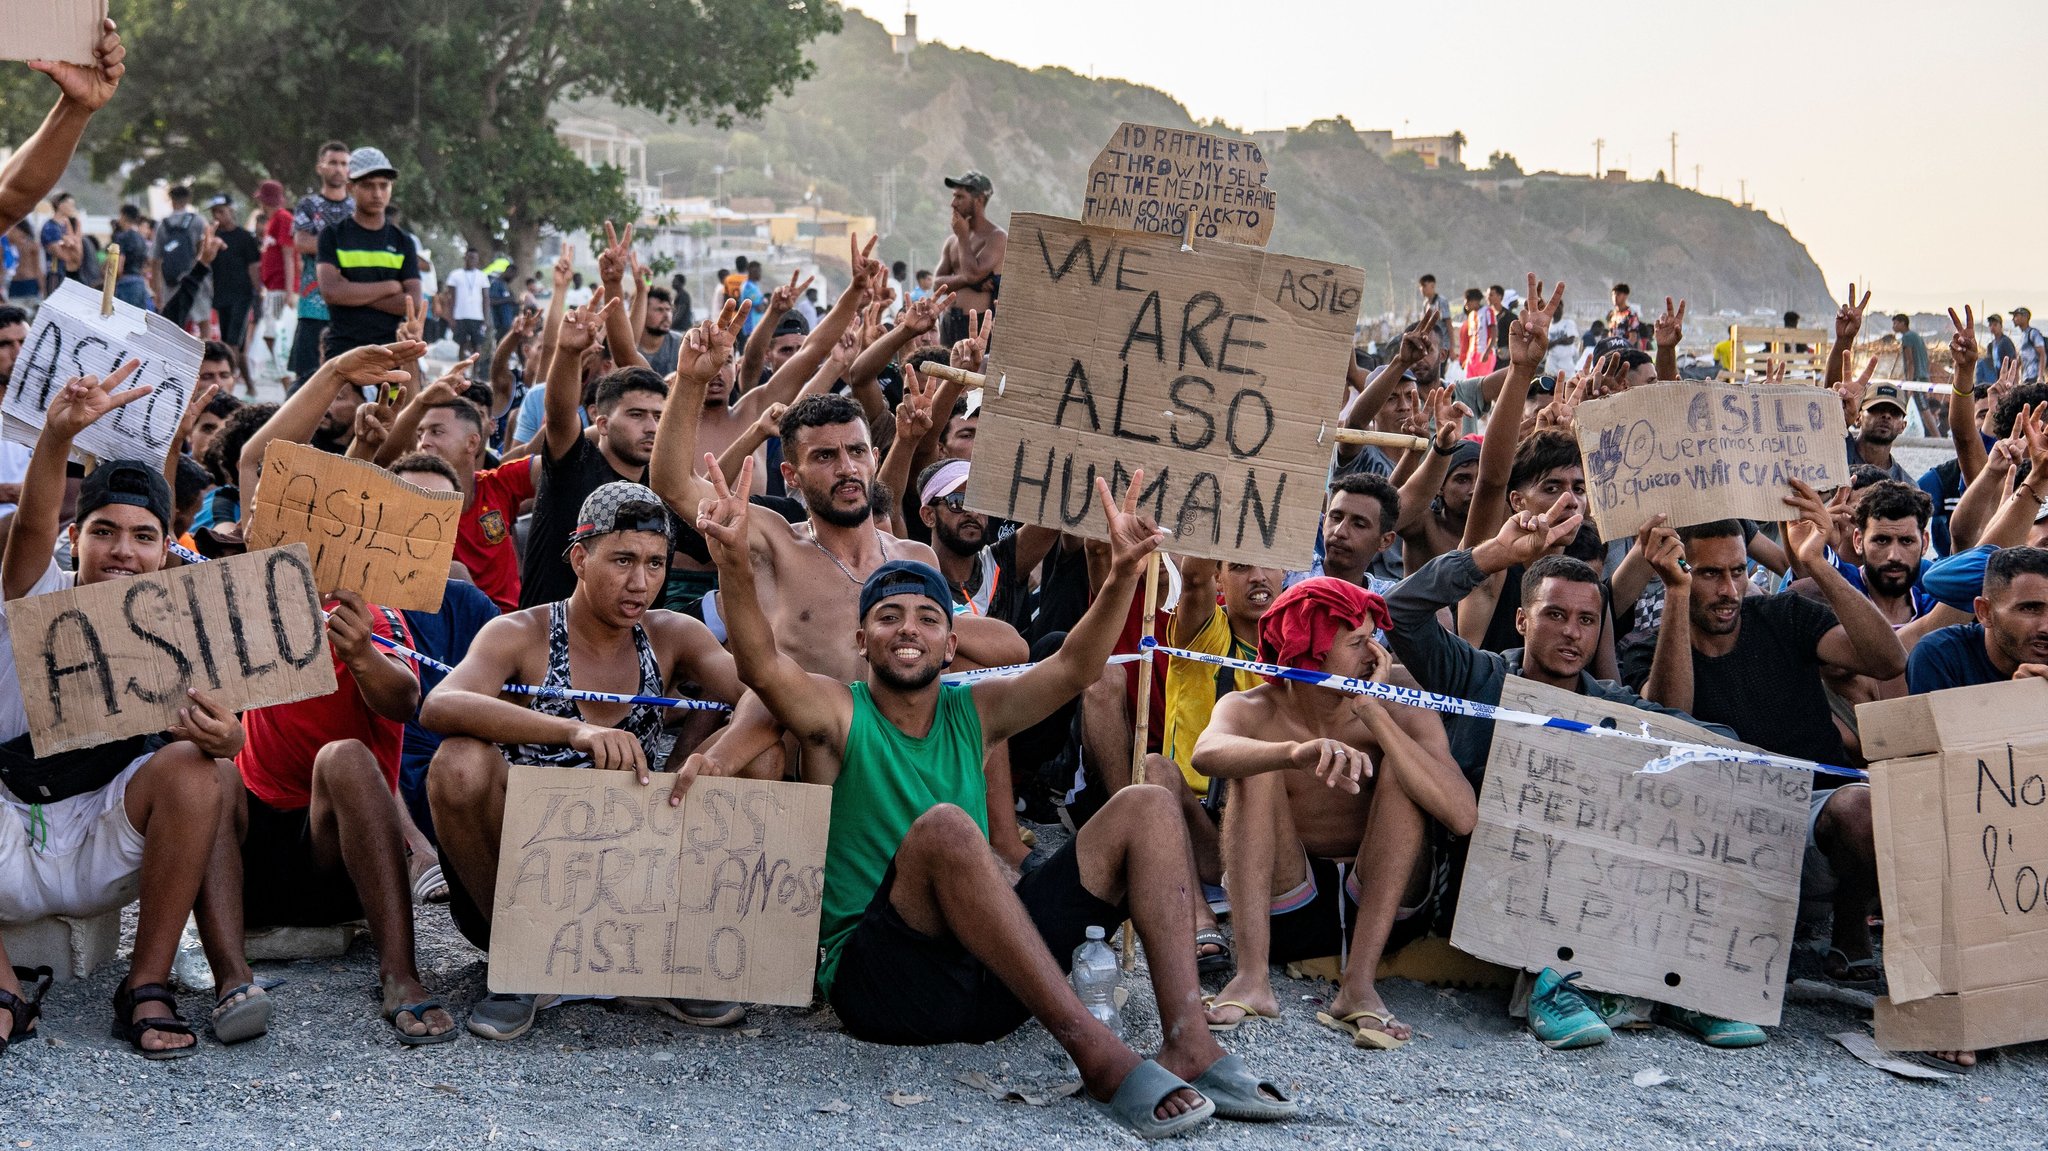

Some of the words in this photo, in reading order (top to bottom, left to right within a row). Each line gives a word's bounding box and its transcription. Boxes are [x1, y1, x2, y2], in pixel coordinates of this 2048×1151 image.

[1108, 150, 1194, 179] THROW
[1198, 161, 1223, 184] MY
[1123, 124, 1146, 148] I'D
[1153, 129, 1240, 162] RATHER
[1243, 144, 1262, 163] TO
[1085, 197, 1133, 217] THAN
[1138, 200, 1185, 219] GOING
[1237, 210, 1260, 228] TO
[1092, 172, 1119, 193] AT
[1123, 176, 1159, 196] THE
[1163, 178, 1277, 210] MEDITERRANE
[1133, 216, 1218, 239] MOROCO
[1037, 228, 1152, 292] WE
[1119, 290, 1268, 375] ARE
[1055, 357, 1275, 458] ALSO
[1008, 438, 1288, 549] HUMAN
[44, 549, 322, 727] ASILO
[1983, 825, 2048, 915] l'o
[546, 919, 746, 981] ASILO
